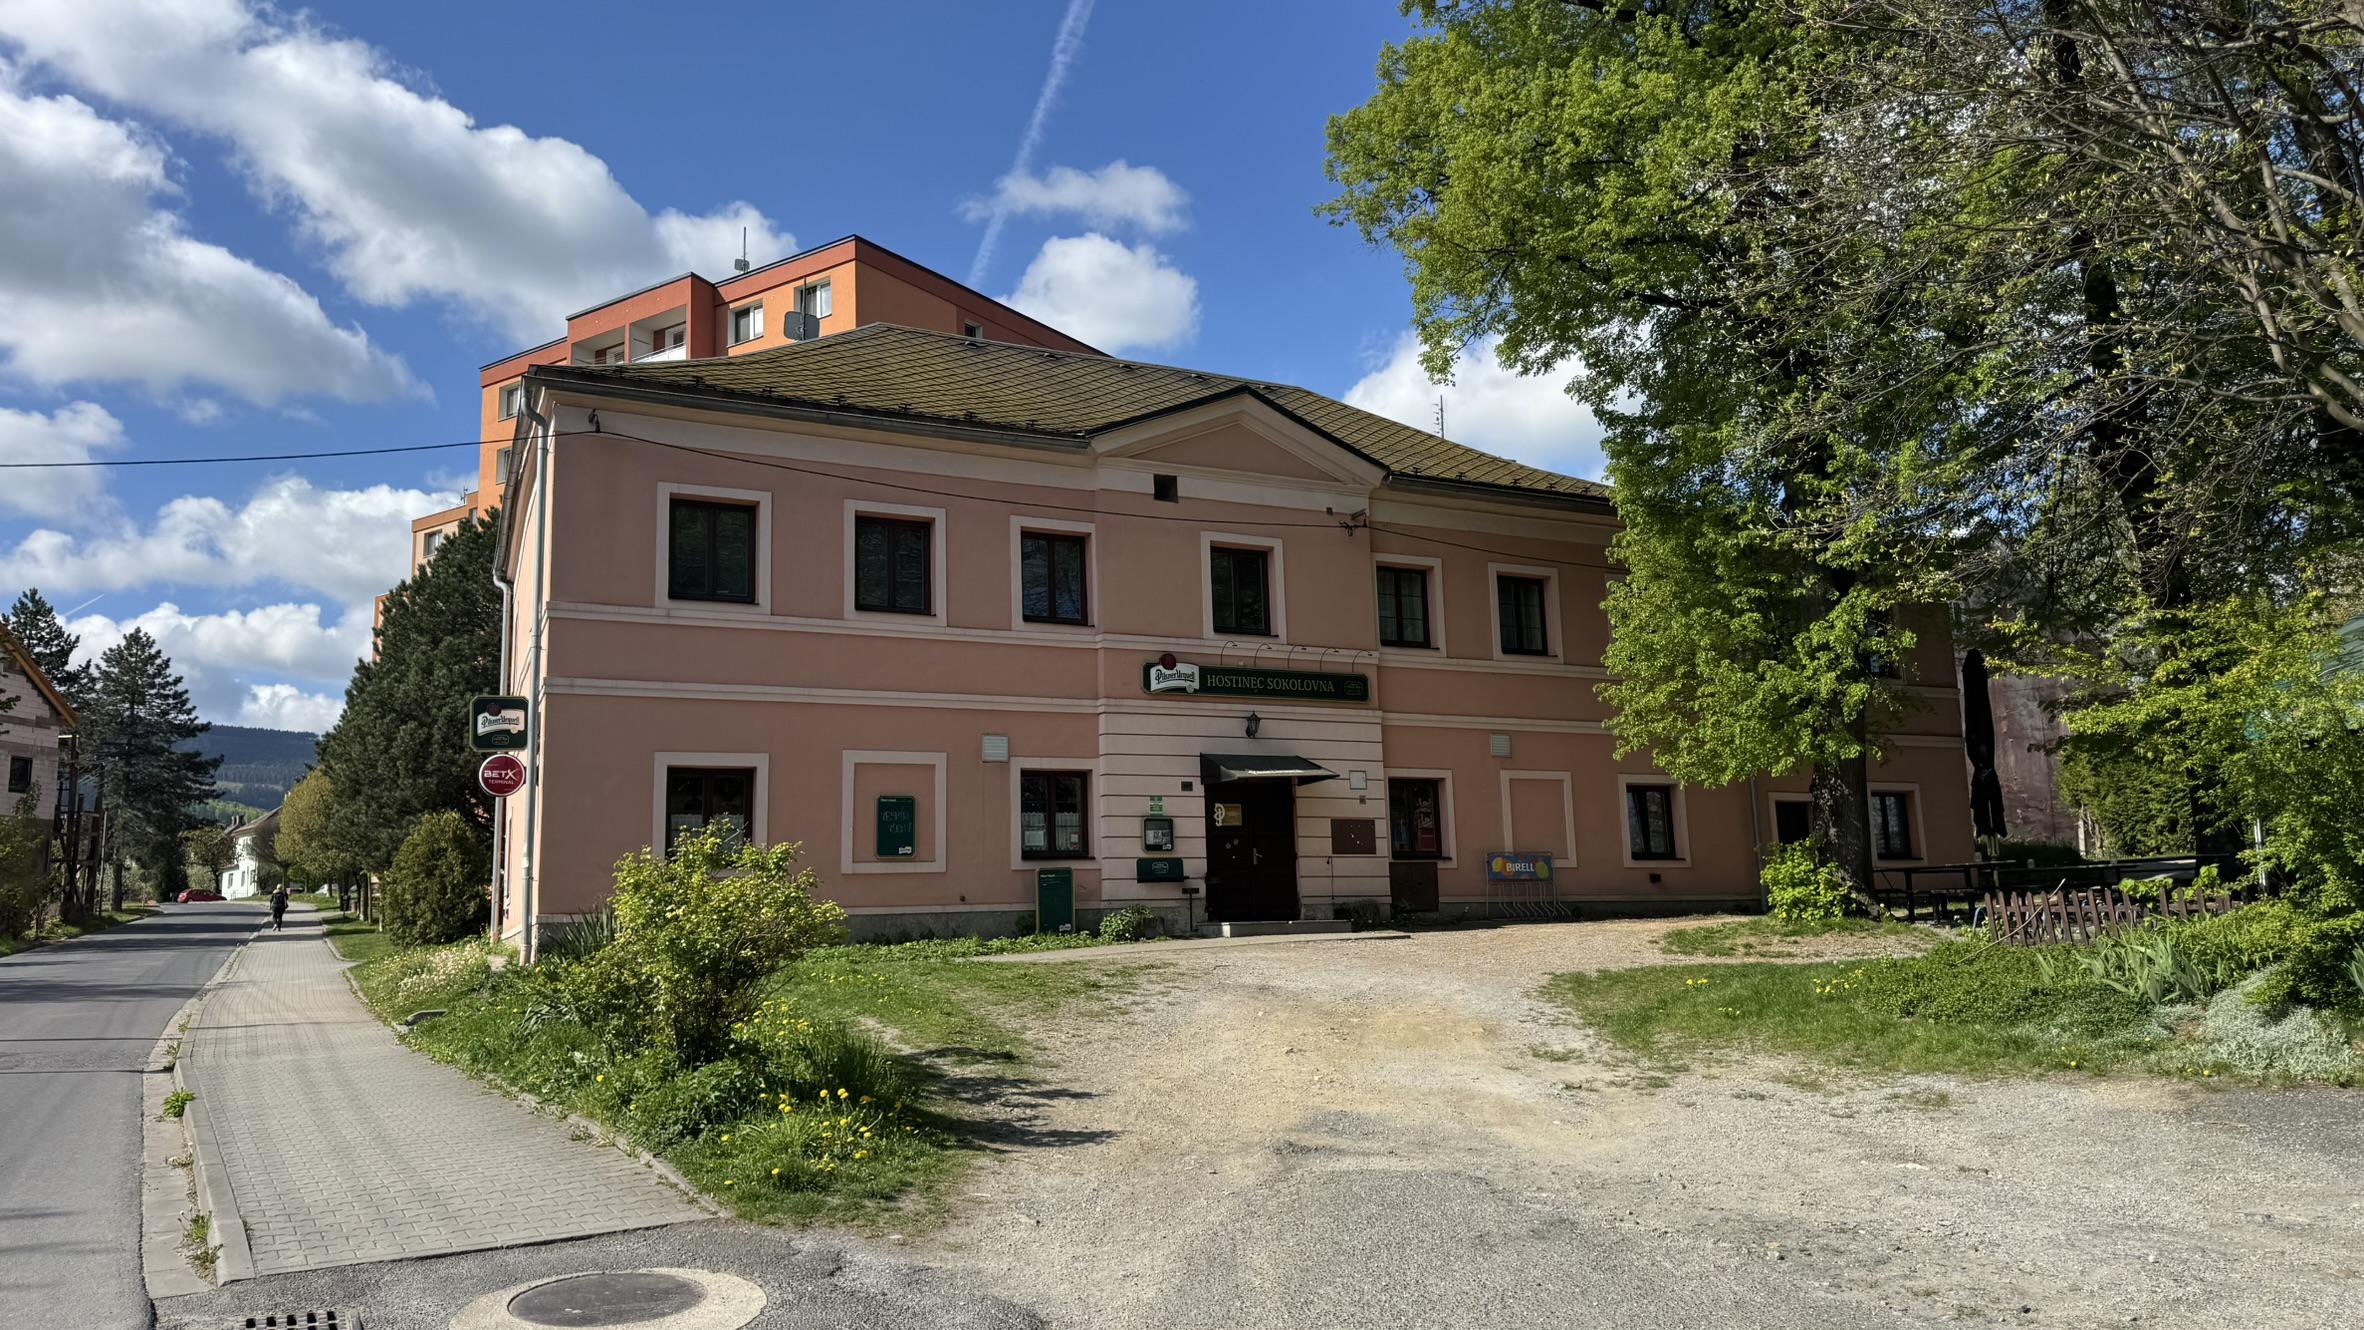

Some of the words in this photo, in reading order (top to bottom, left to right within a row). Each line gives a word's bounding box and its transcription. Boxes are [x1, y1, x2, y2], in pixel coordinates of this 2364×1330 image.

[1155, 668, 1176, 685] Pilsner
[1175, 668, 1195, 683] Urquell
[1206, 674, 1264, 689] HOSTINEC
[1267, 677, 1335, 693] SOKOLOVNA
[481, 716, 501, 728] Pilsner
[501, 715, 520, 725] Urquell
[484, 768, 518, 781] BETX
[1506, 862, 1535, 872] BIRELL
